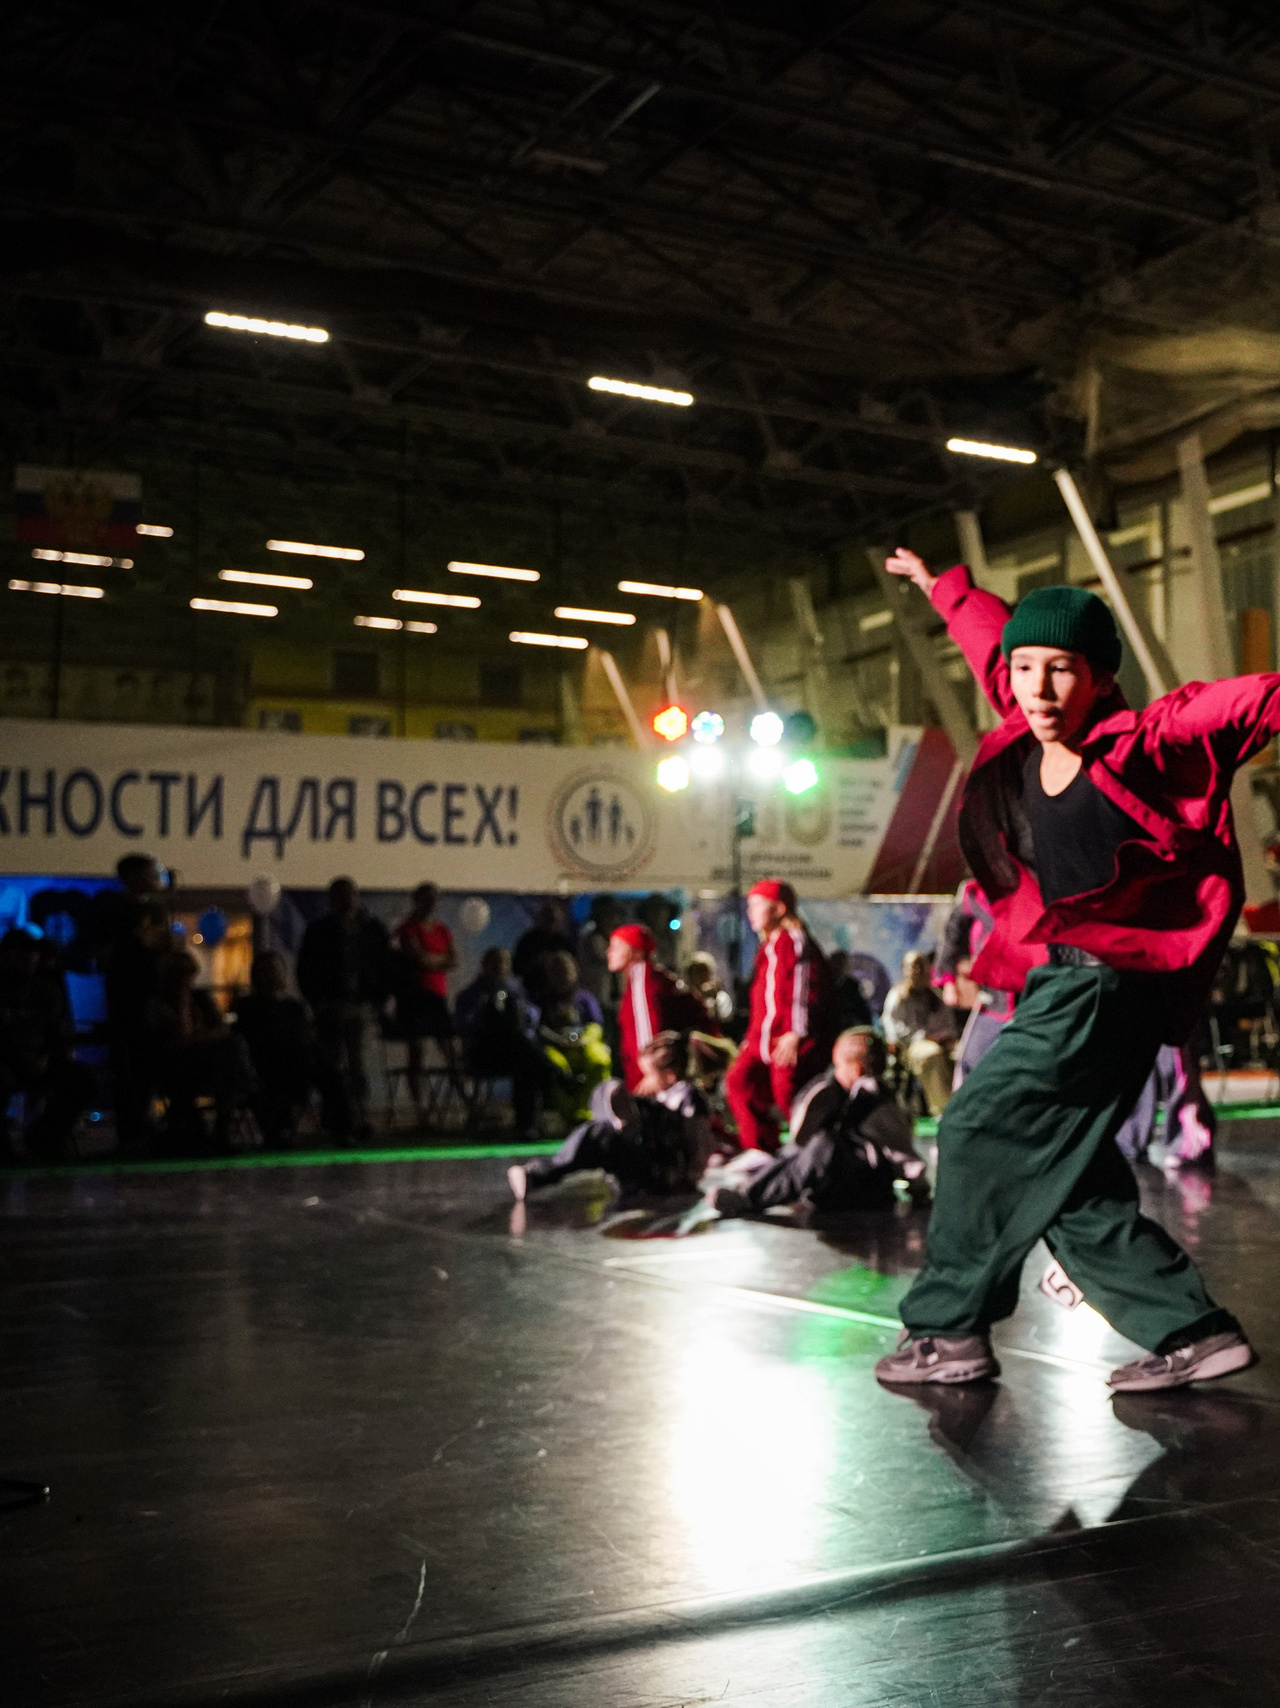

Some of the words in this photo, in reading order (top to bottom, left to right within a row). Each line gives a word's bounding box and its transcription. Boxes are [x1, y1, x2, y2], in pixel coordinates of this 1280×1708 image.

[0, 767, 224, 839] НОСТИ
[241, 775, 357, 860] ДЛЯ
[377, 778, 519, 846] ВСЕХ!
